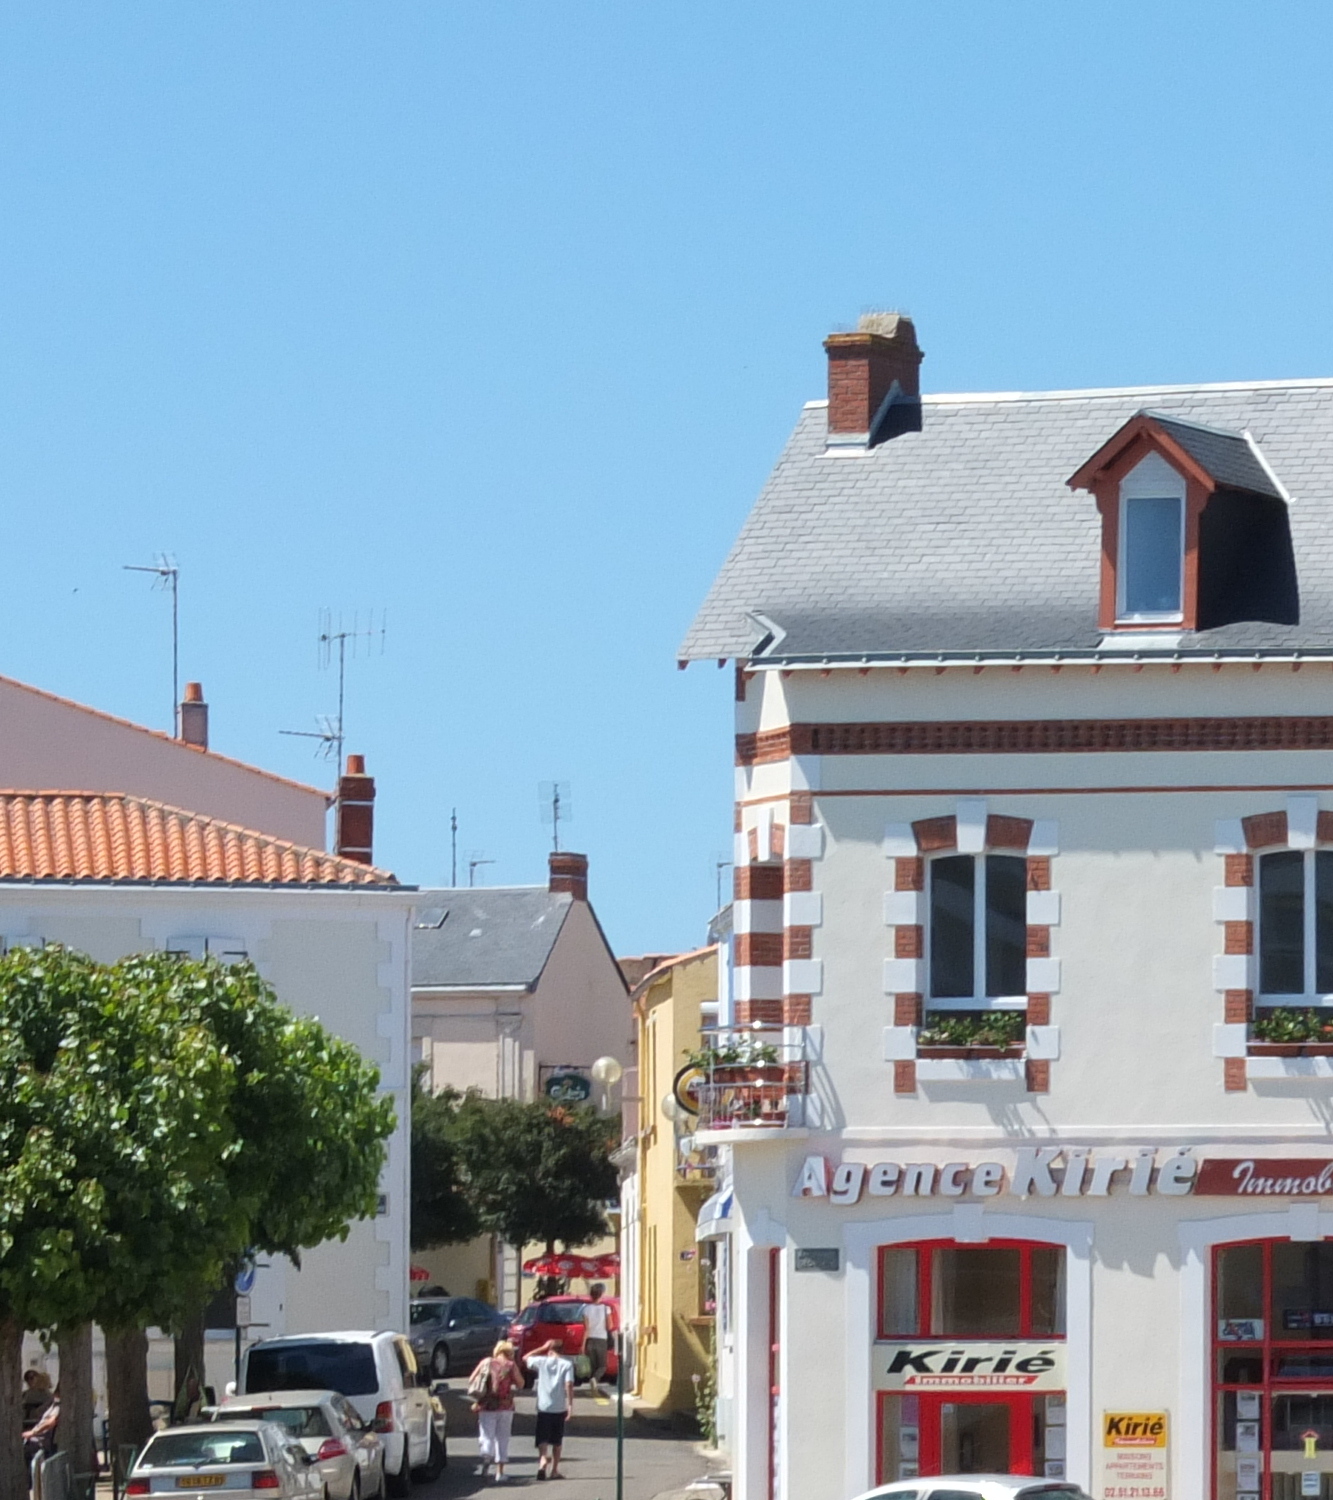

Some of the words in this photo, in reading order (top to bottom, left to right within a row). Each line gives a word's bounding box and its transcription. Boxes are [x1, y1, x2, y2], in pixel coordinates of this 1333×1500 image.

[792, 1155, 1004, 1205] Agence
[1009, 1146, 1198, 1196] Kirié
[886, 1349, 1056, 1374] Kirié
[914, 1375, 1028, 1386] Immobilier
[1106, 1416, 1164, 1436] Kirié
